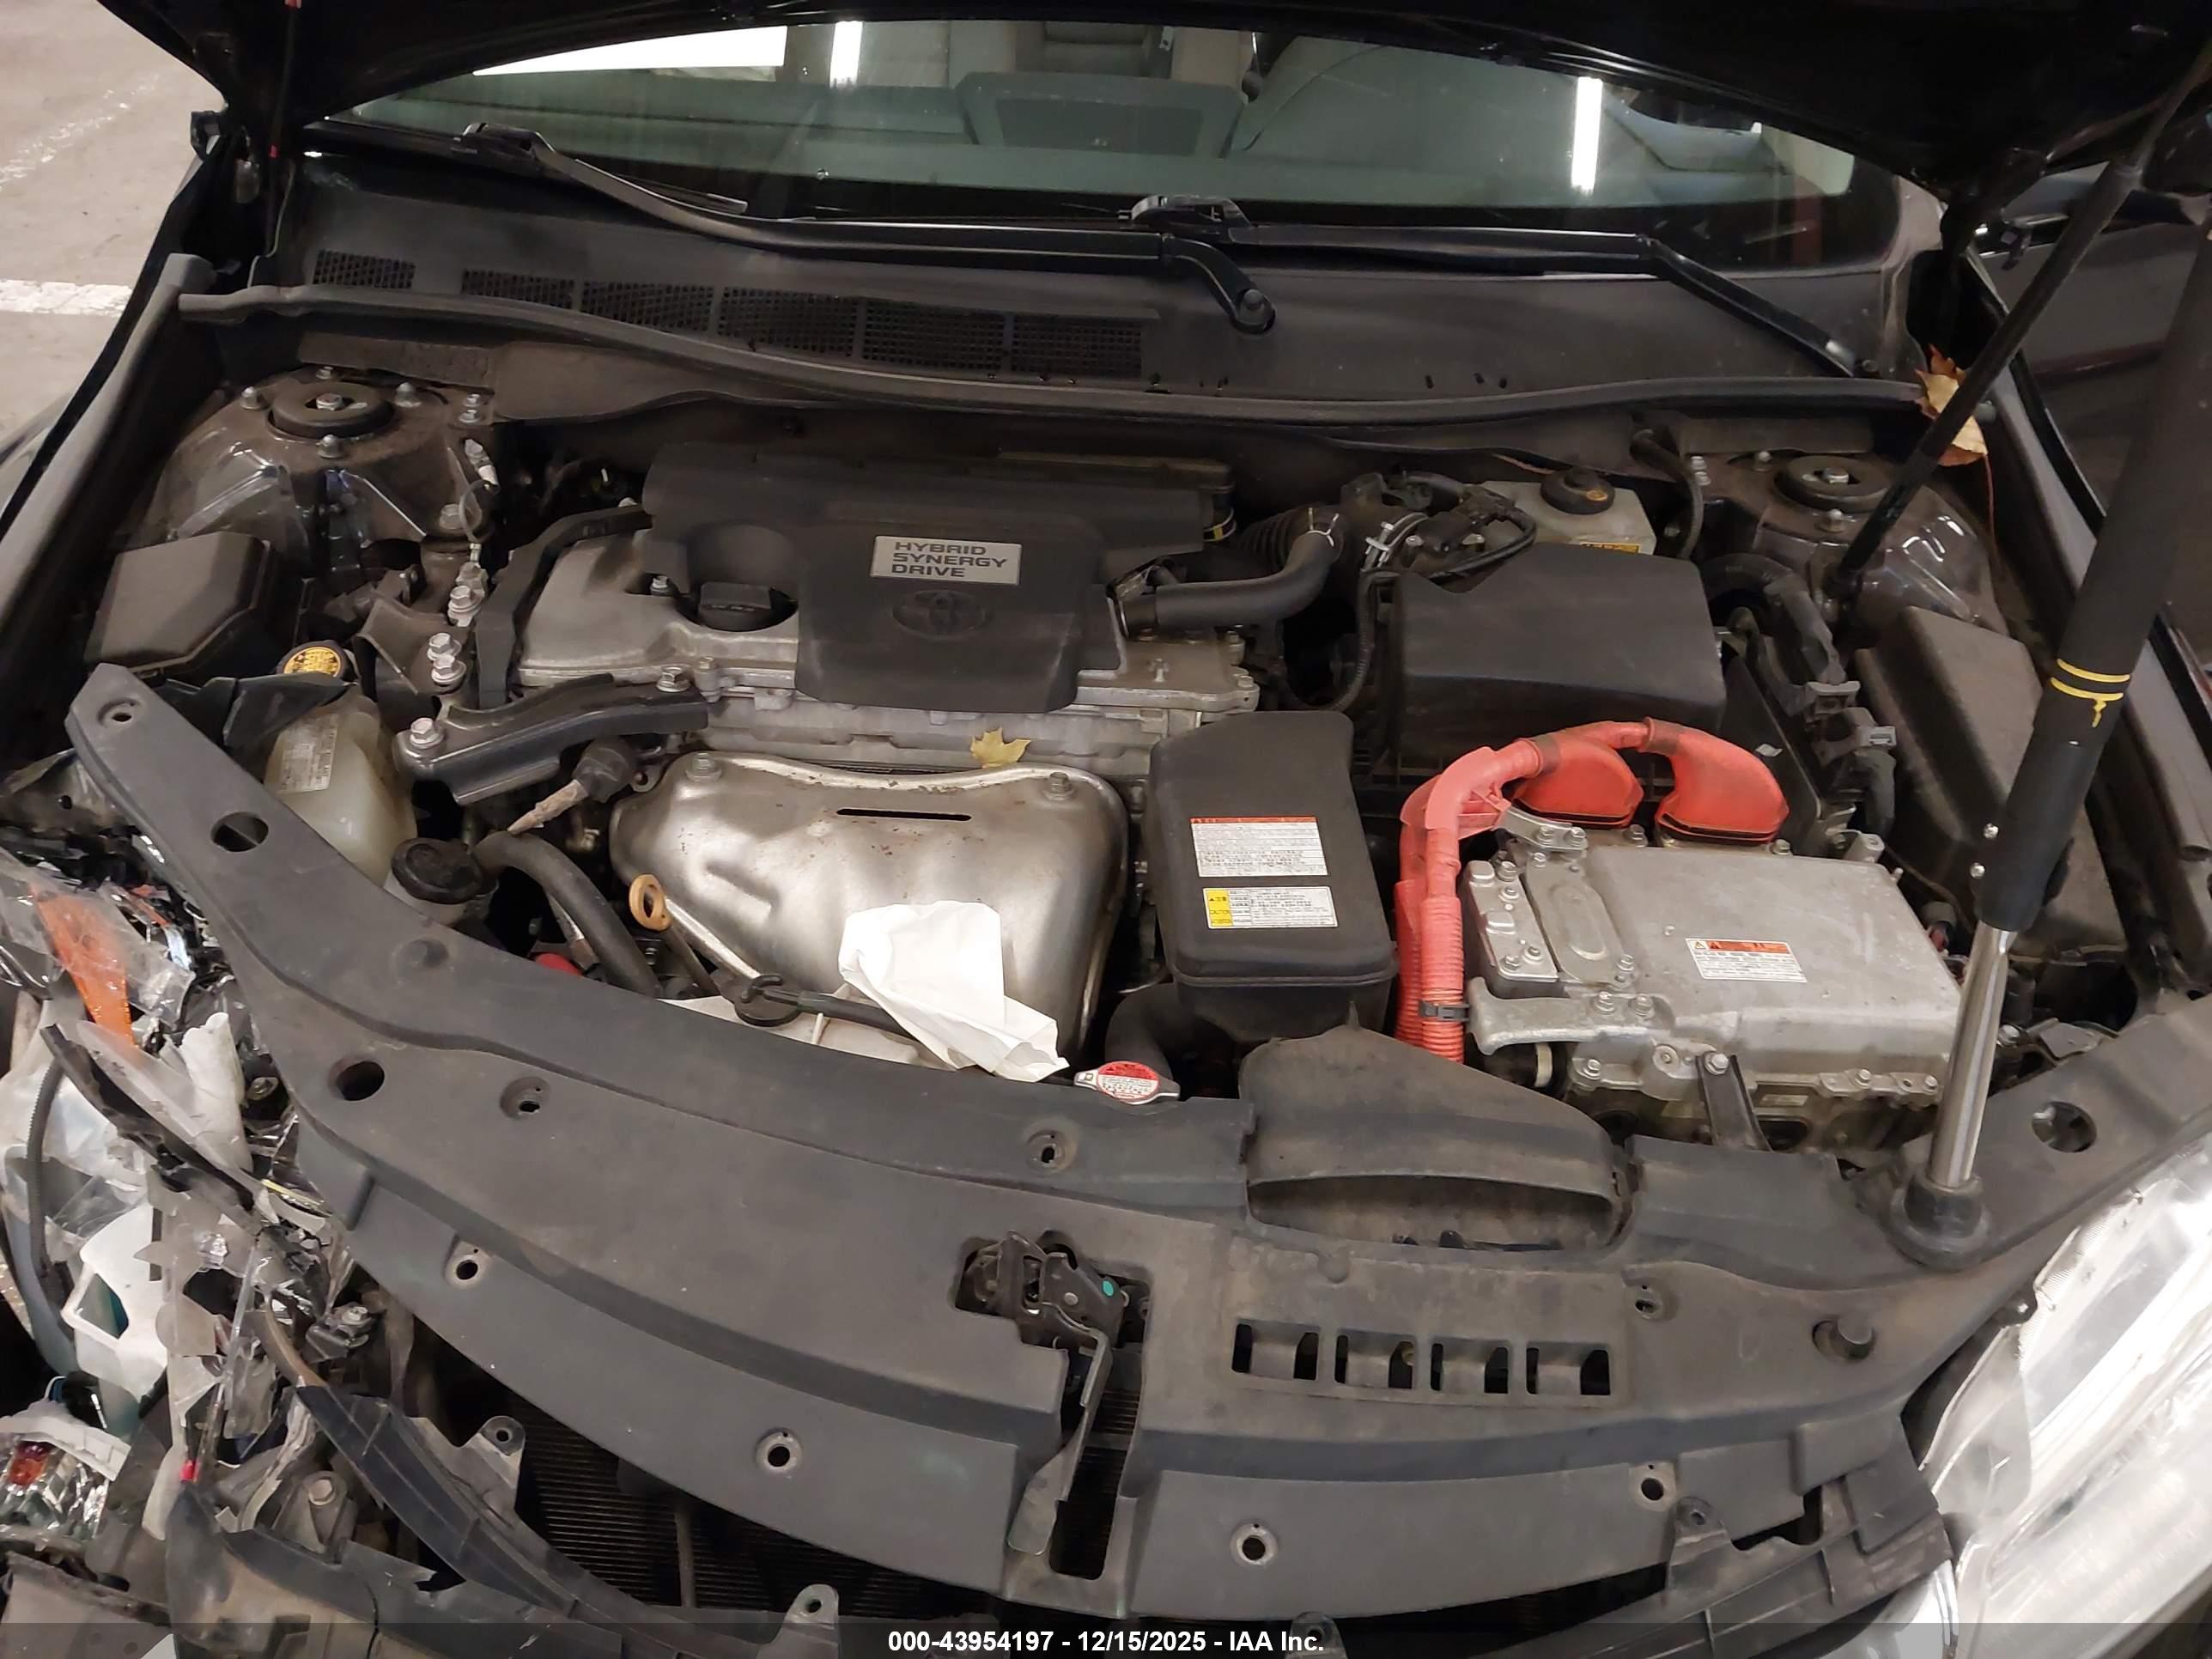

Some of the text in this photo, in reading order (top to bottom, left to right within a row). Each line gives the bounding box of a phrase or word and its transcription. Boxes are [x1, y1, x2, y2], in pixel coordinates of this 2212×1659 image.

[896, 542, 987, 555] HYBRID
[893, 553, 1007, 568] SYNERGY
[891, 564, 965, 577] DRIVE
